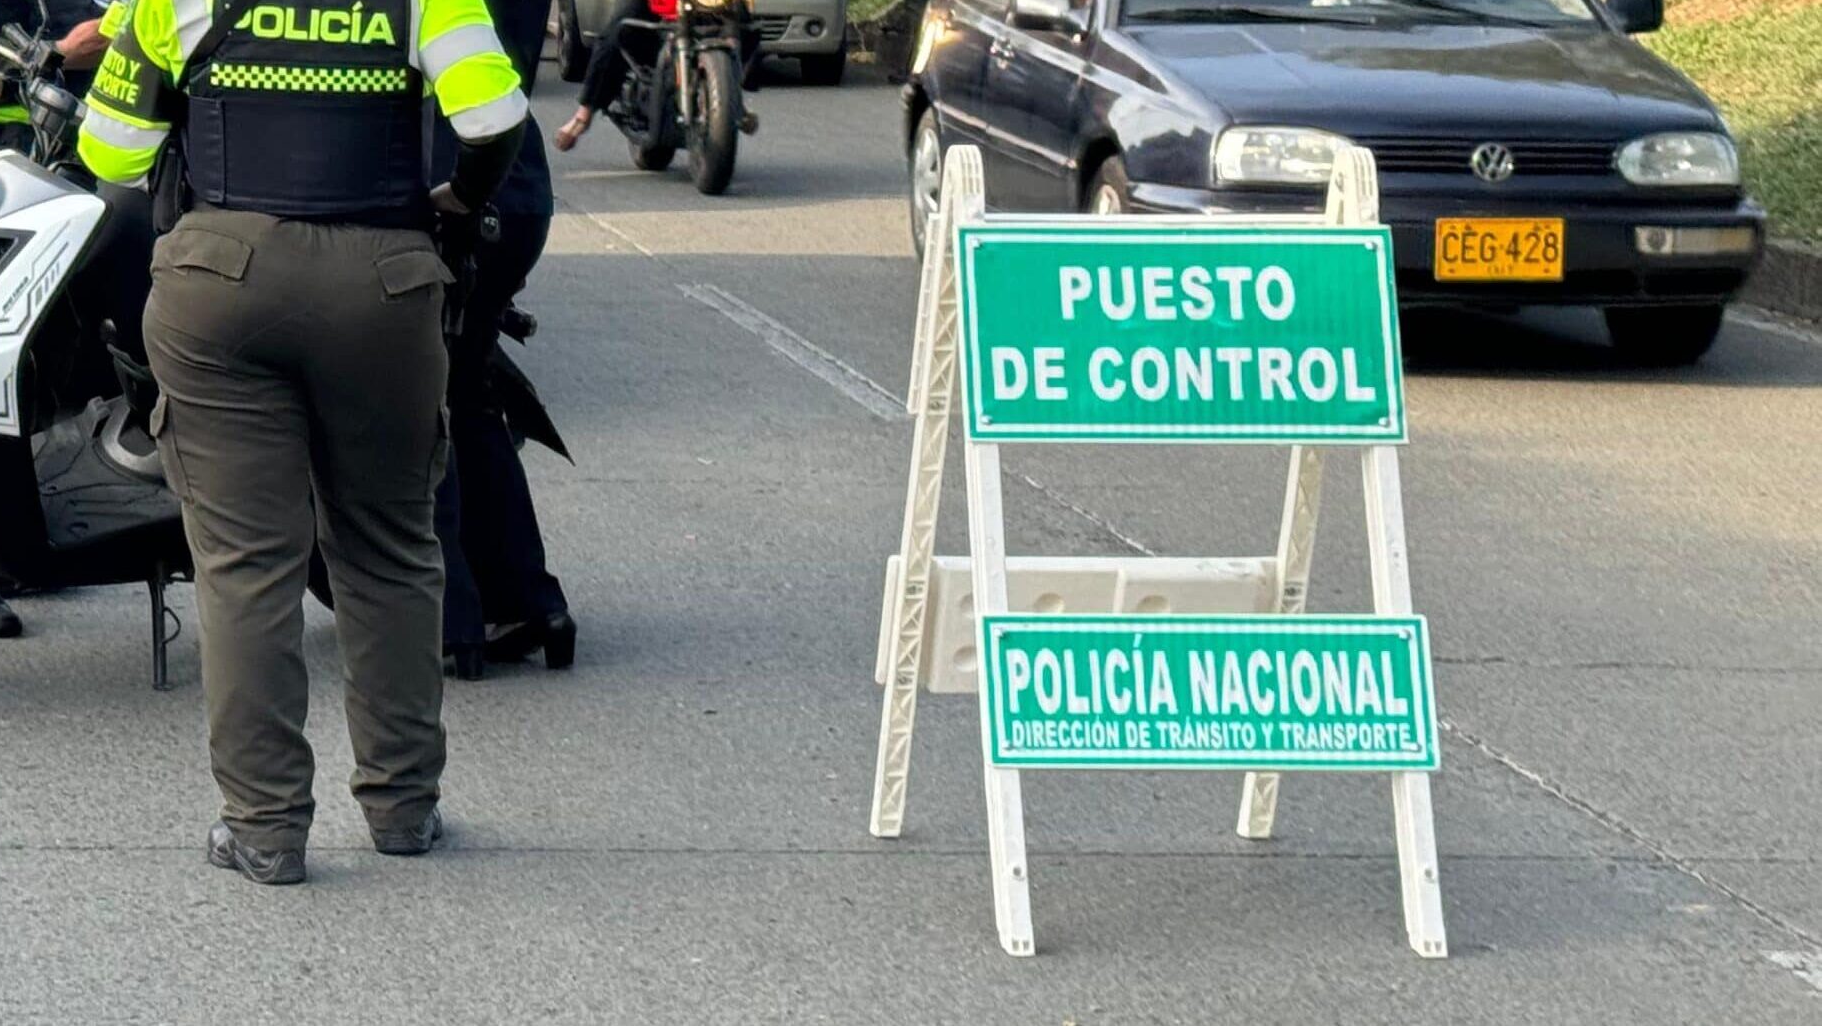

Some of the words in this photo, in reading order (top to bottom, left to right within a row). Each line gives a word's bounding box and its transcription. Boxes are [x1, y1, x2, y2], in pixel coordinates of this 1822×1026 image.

[129, 60, 141, 82] Y
[1058, 265, 1296, 321] PUESTO
[990, 346, 1069, 401] DE
[1088, 346, 1377, 402] CONTROL
[1005, 633, 1179, 716] POLICÍA
[1188, 649, 1409, 717] NACIONAL
[1011, 715, 1120, 749] DIRECCIÓN
[1125, 720, 1152, 749] DE
[1261, 722, 1275, 749] Y
[1279, 721, 1413, 752] TRANSPORTE
